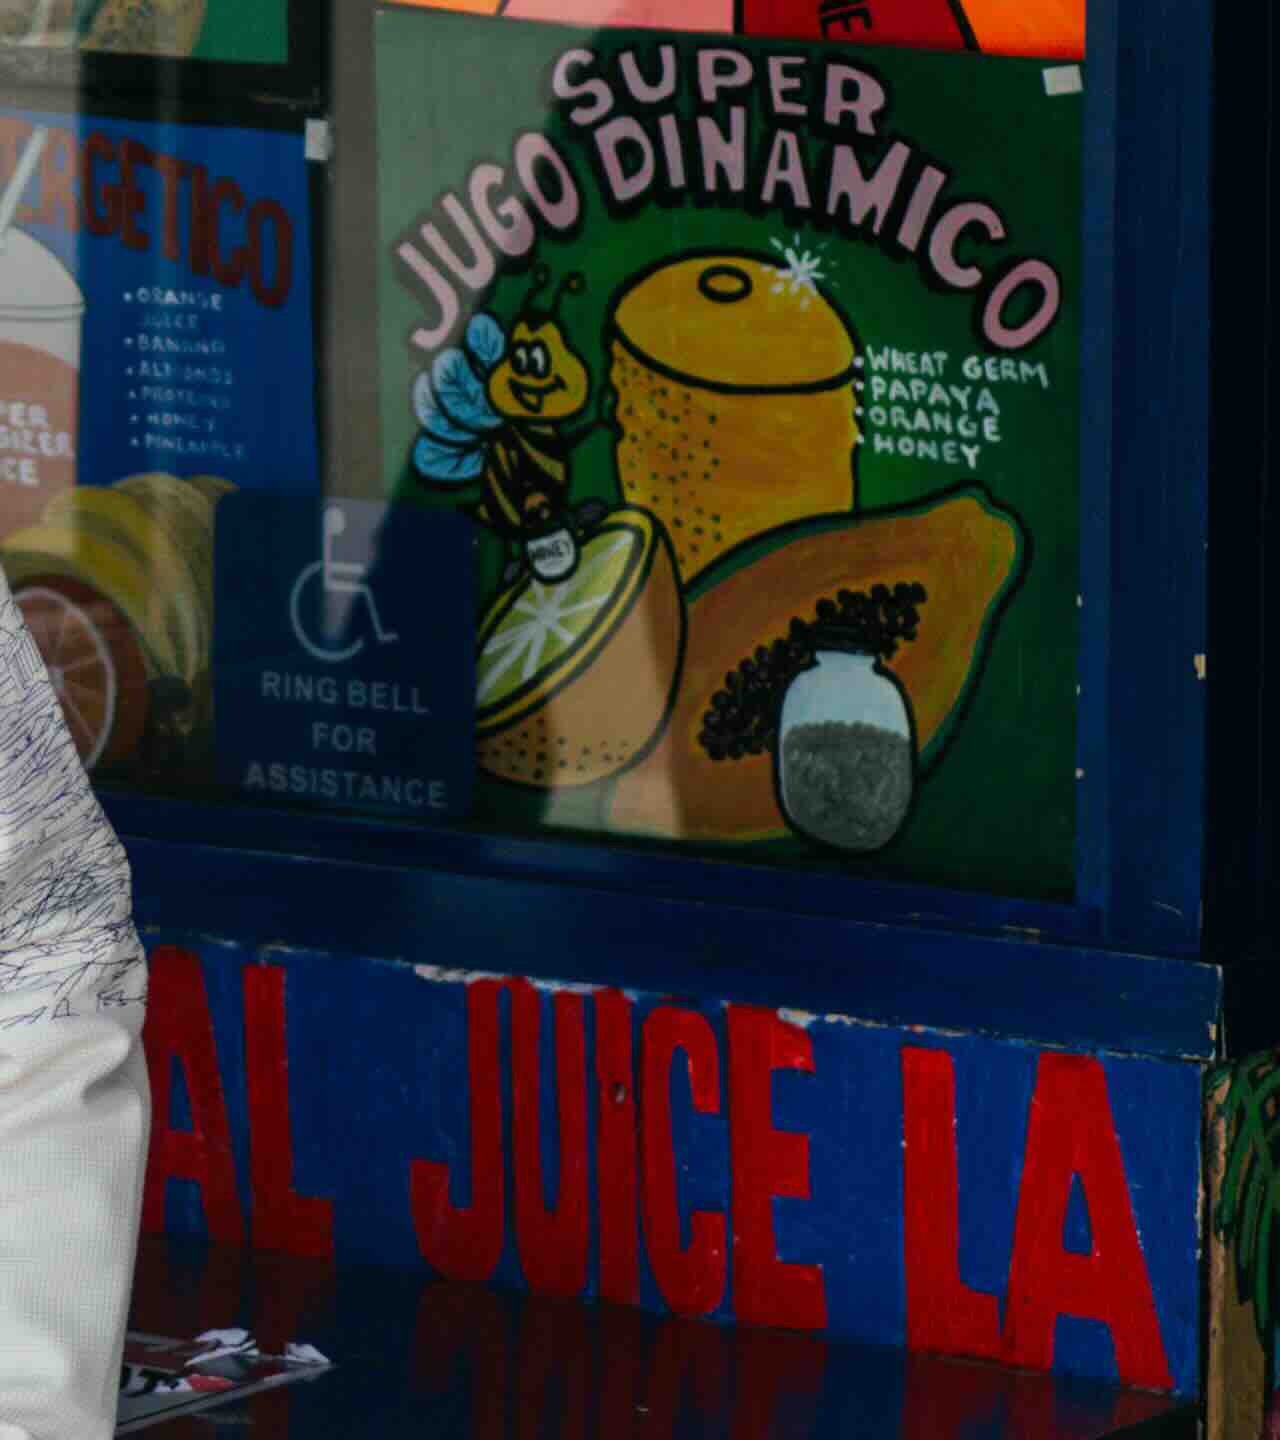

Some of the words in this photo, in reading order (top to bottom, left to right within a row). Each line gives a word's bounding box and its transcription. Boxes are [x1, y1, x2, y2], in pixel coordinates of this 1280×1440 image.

[550, 41, 888, 136] SUPER
[394, 131, 584, 352] JUGO
[592, 105, 1064, 351] DINAMICO
[865, 343, 950, 378] WHEAT
[960, 353, 1050, 391] GERM
[869, 374, 1001, 416] PAPAYA
[867, 404, 1002, 444] ORANGE
[872, 431, 982, 470] HONEY
[260, 670, 339, 706] RING
[346, 678, 433, 717] BELL
[311, 720, 377, 758] FOR
[241, 759, 449, 809] ASSISTANCE
[409, 978, 830, 1336] JUICE
[898, 1044, 1180, 1396] LA
